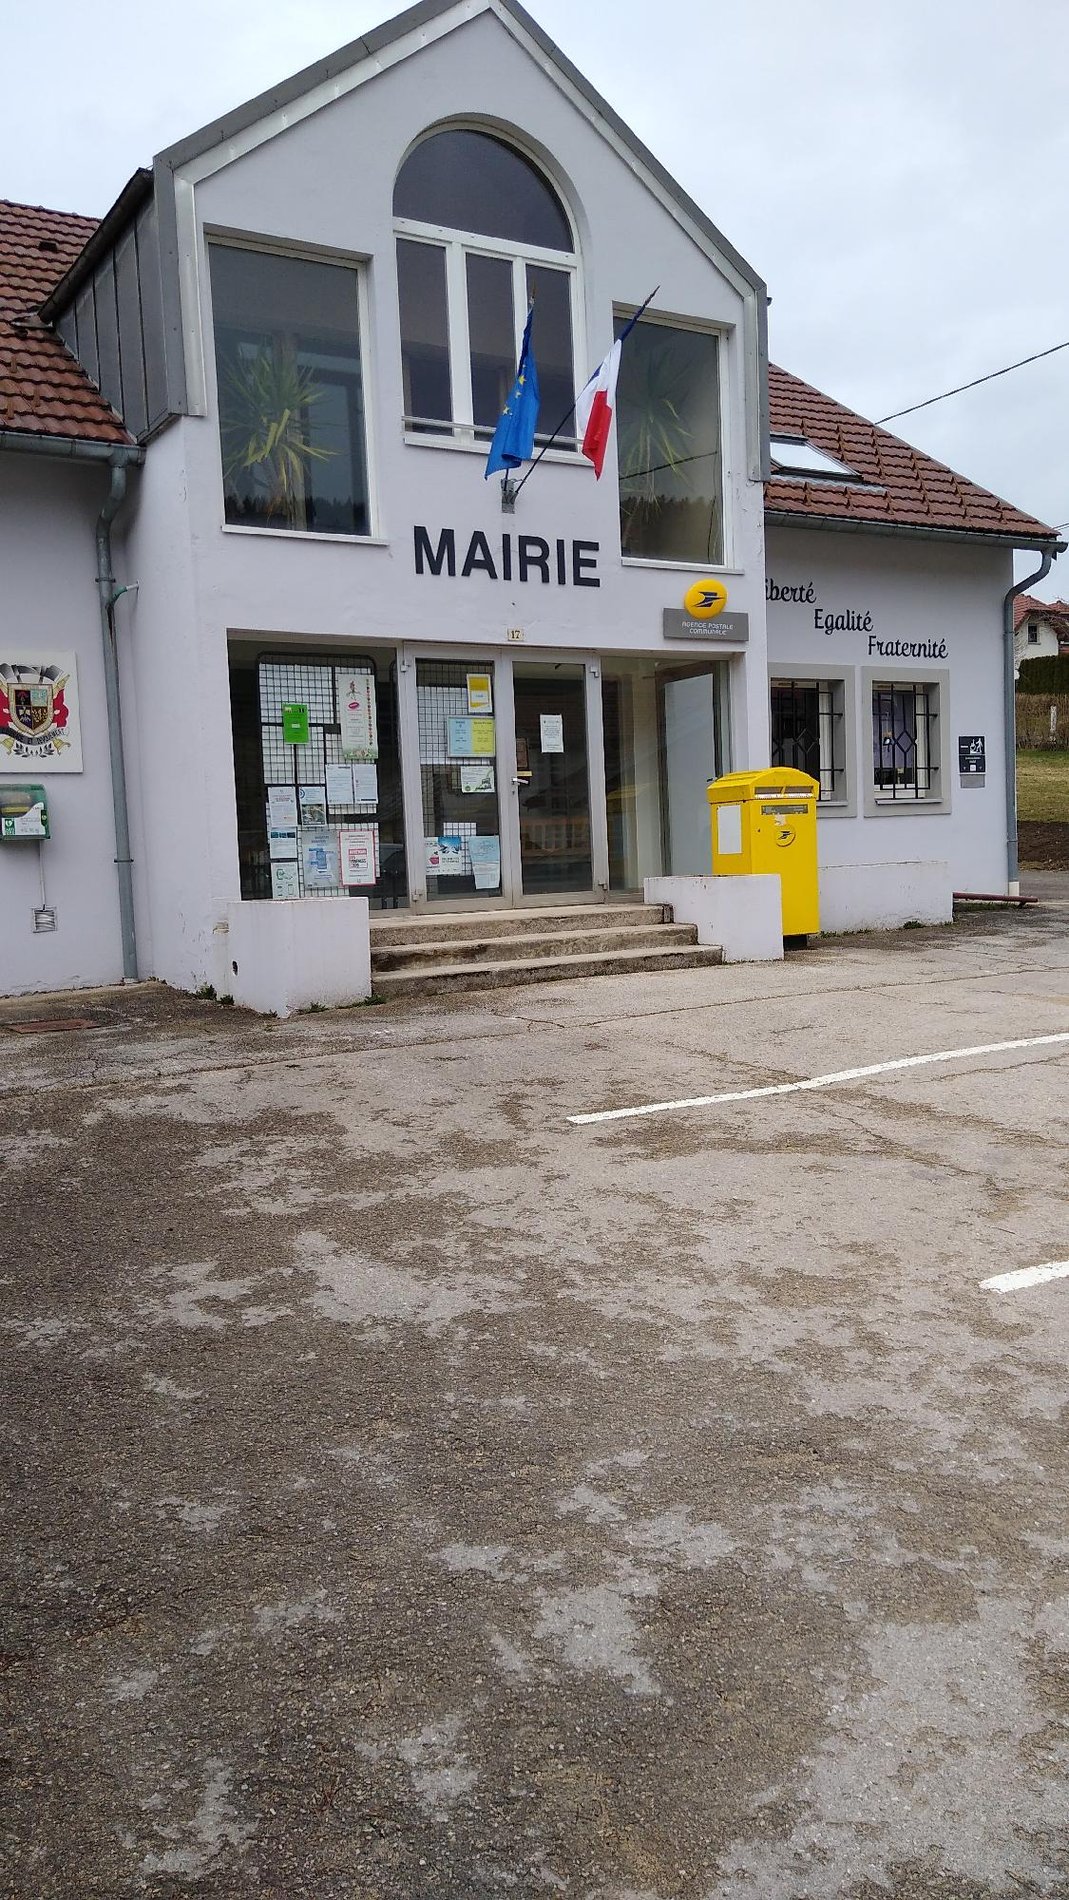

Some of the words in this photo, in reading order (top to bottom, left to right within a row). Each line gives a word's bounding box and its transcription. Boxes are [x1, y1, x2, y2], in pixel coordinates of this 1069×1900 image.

[413, 525, 601, 588] MAIRIE
[765, 578, 817, 604] iberté
[511, 630, 520, 639] 17
[814, 608, 874, 635] Egalité
[868, 635, 949, 660] Fraternité
